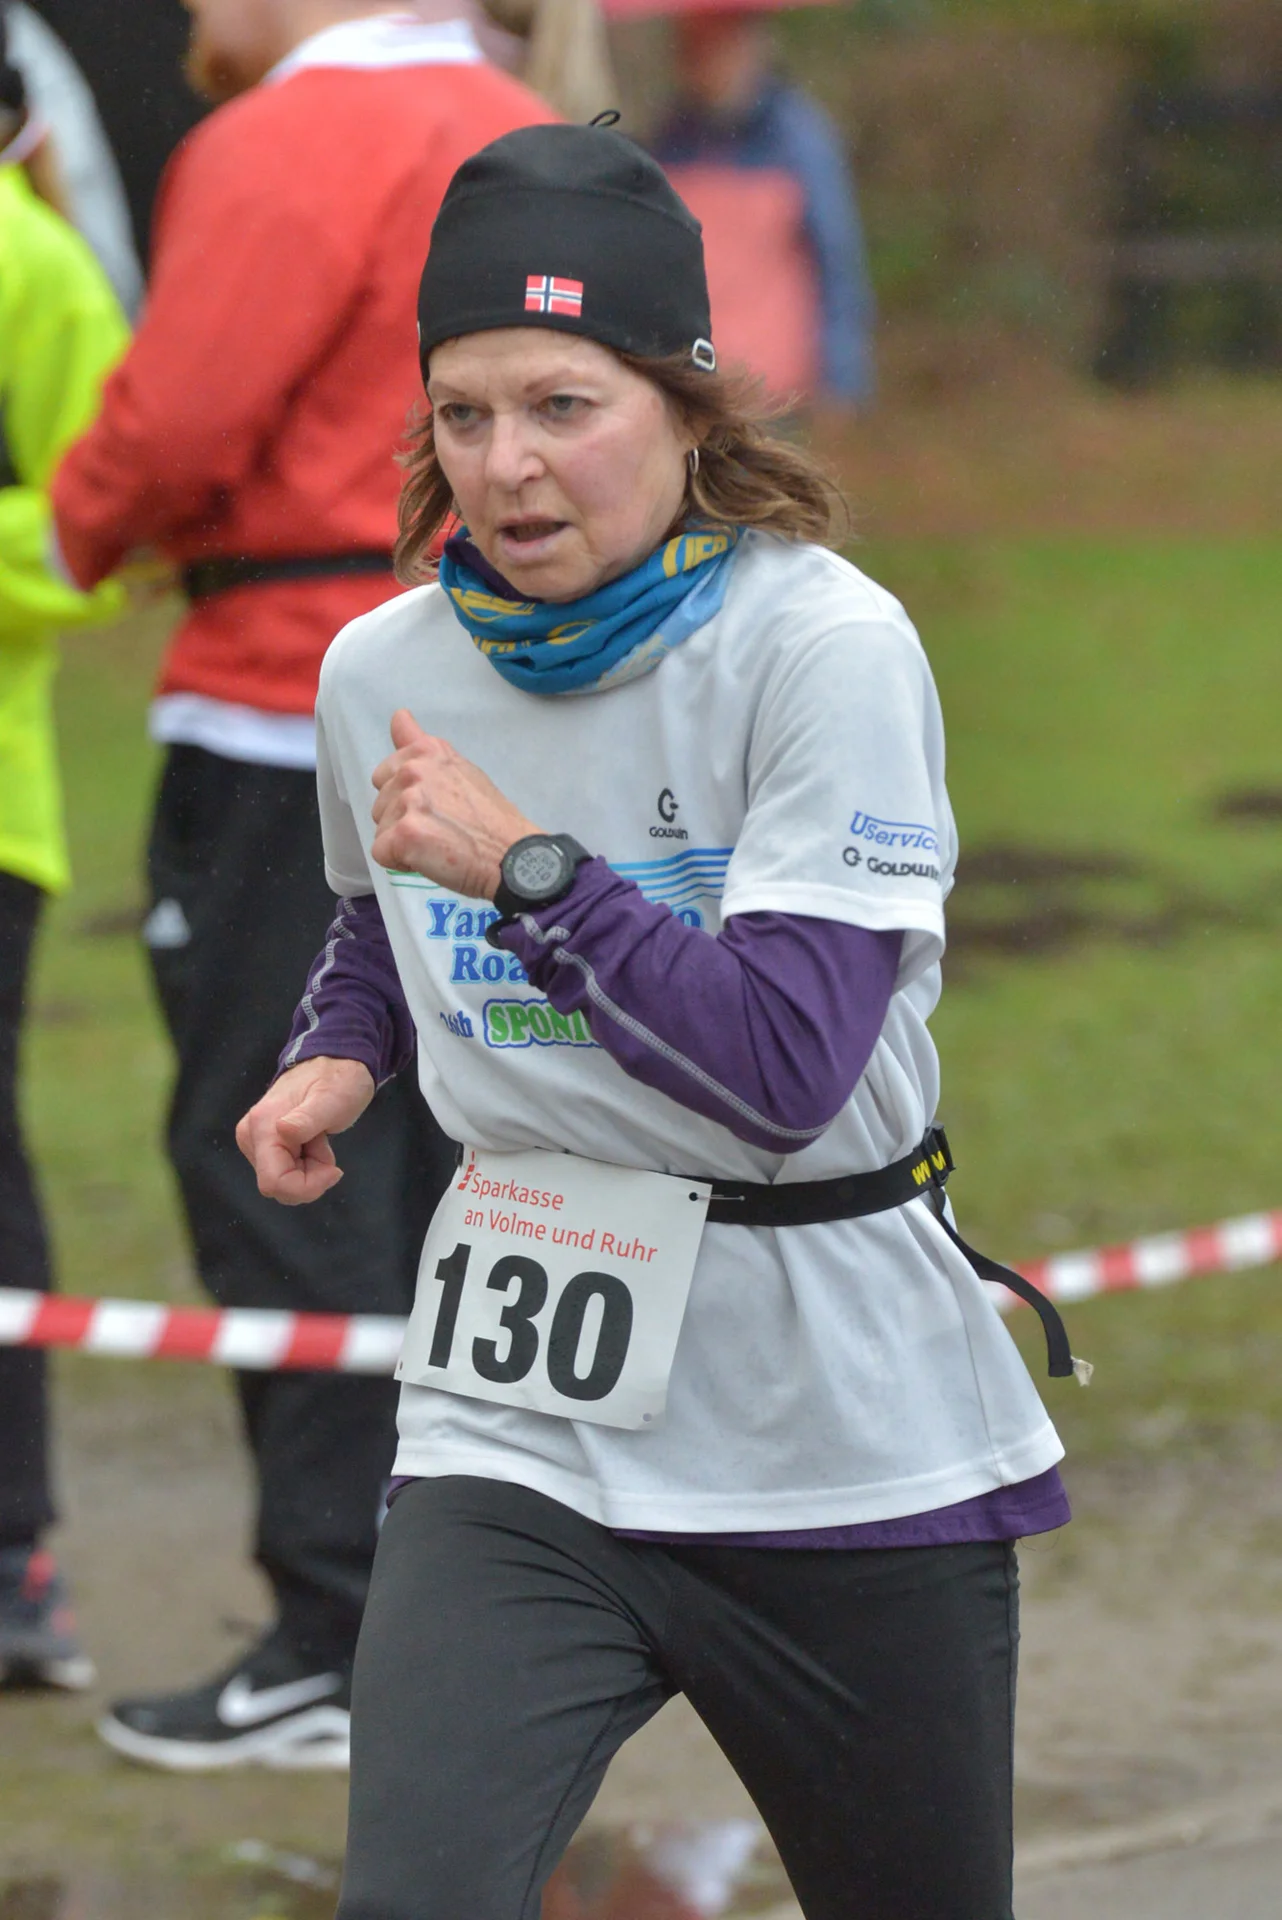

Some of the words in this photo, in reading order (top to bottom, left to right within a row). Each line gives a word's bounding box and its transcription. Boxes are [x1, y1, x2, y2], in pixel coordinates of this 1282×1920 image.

[470, 1172, 564, 1211] Sparkasse
[464, 1208, 484, 1228] an
[489, 1208, 546, 1241] Volme
[552, 1228, 596, 1250] und
[600, 1231, 658, 1263] Ruhr
[427, 1242, 633, 1401] 130
